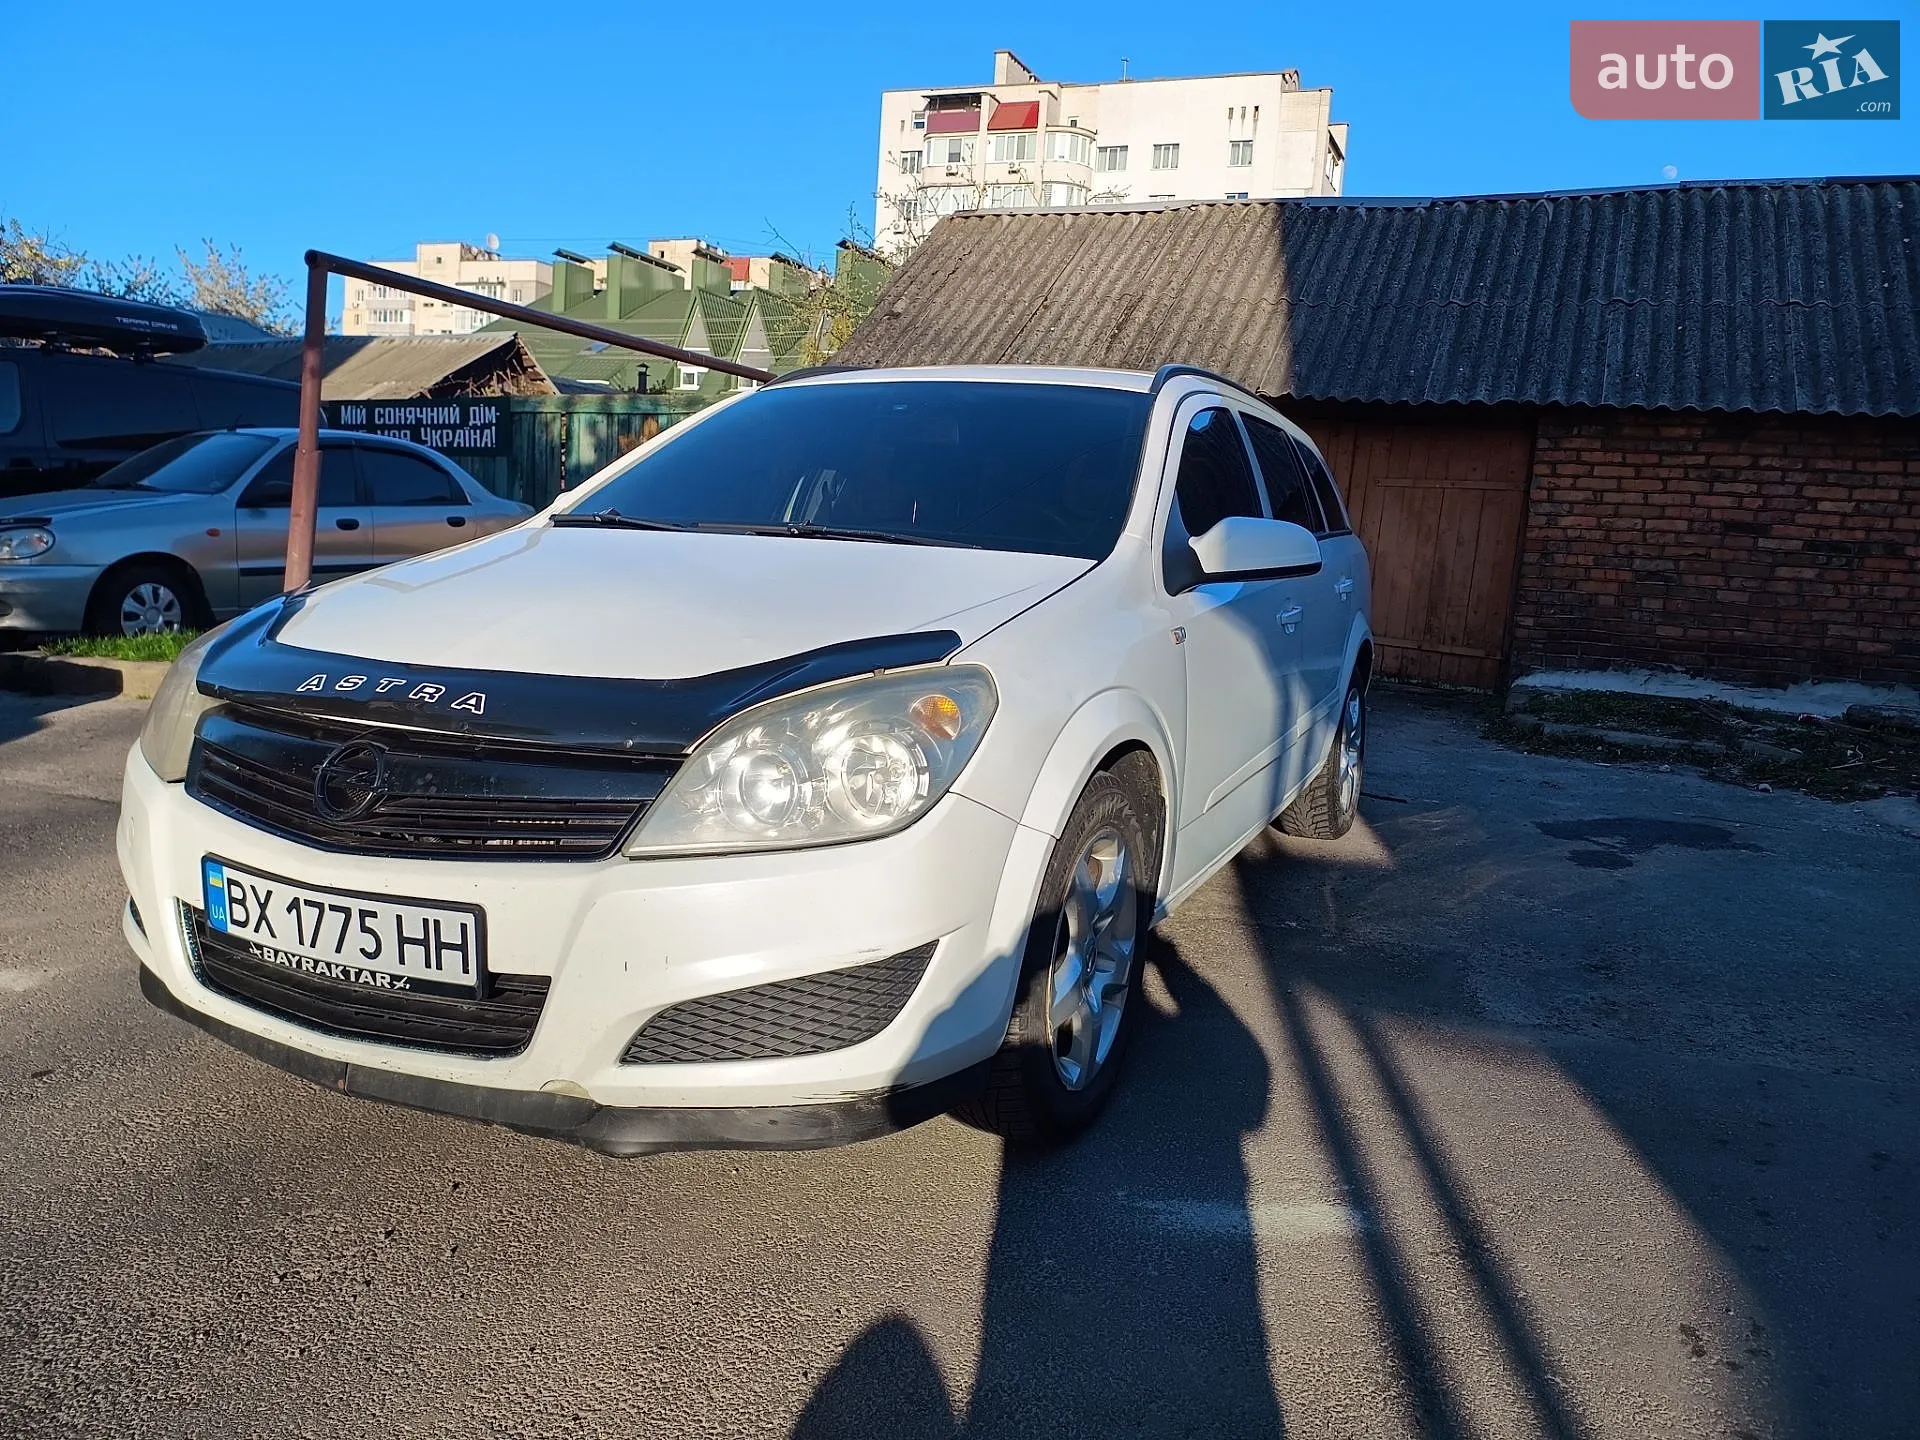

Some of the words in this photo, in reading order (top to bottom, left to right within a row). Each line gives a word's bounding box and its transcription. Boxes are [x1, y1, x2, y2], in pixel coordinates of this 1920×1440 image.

[295, 674, 487, 716] ASTRA
[211, 903, 226, 922] UA
[226, 876, 278, 939] BX
[285, 896, 384, 961] 1775
[395, 912, 471, 975] HH
[262, 946, 392, 989] BAYRAKTAR
